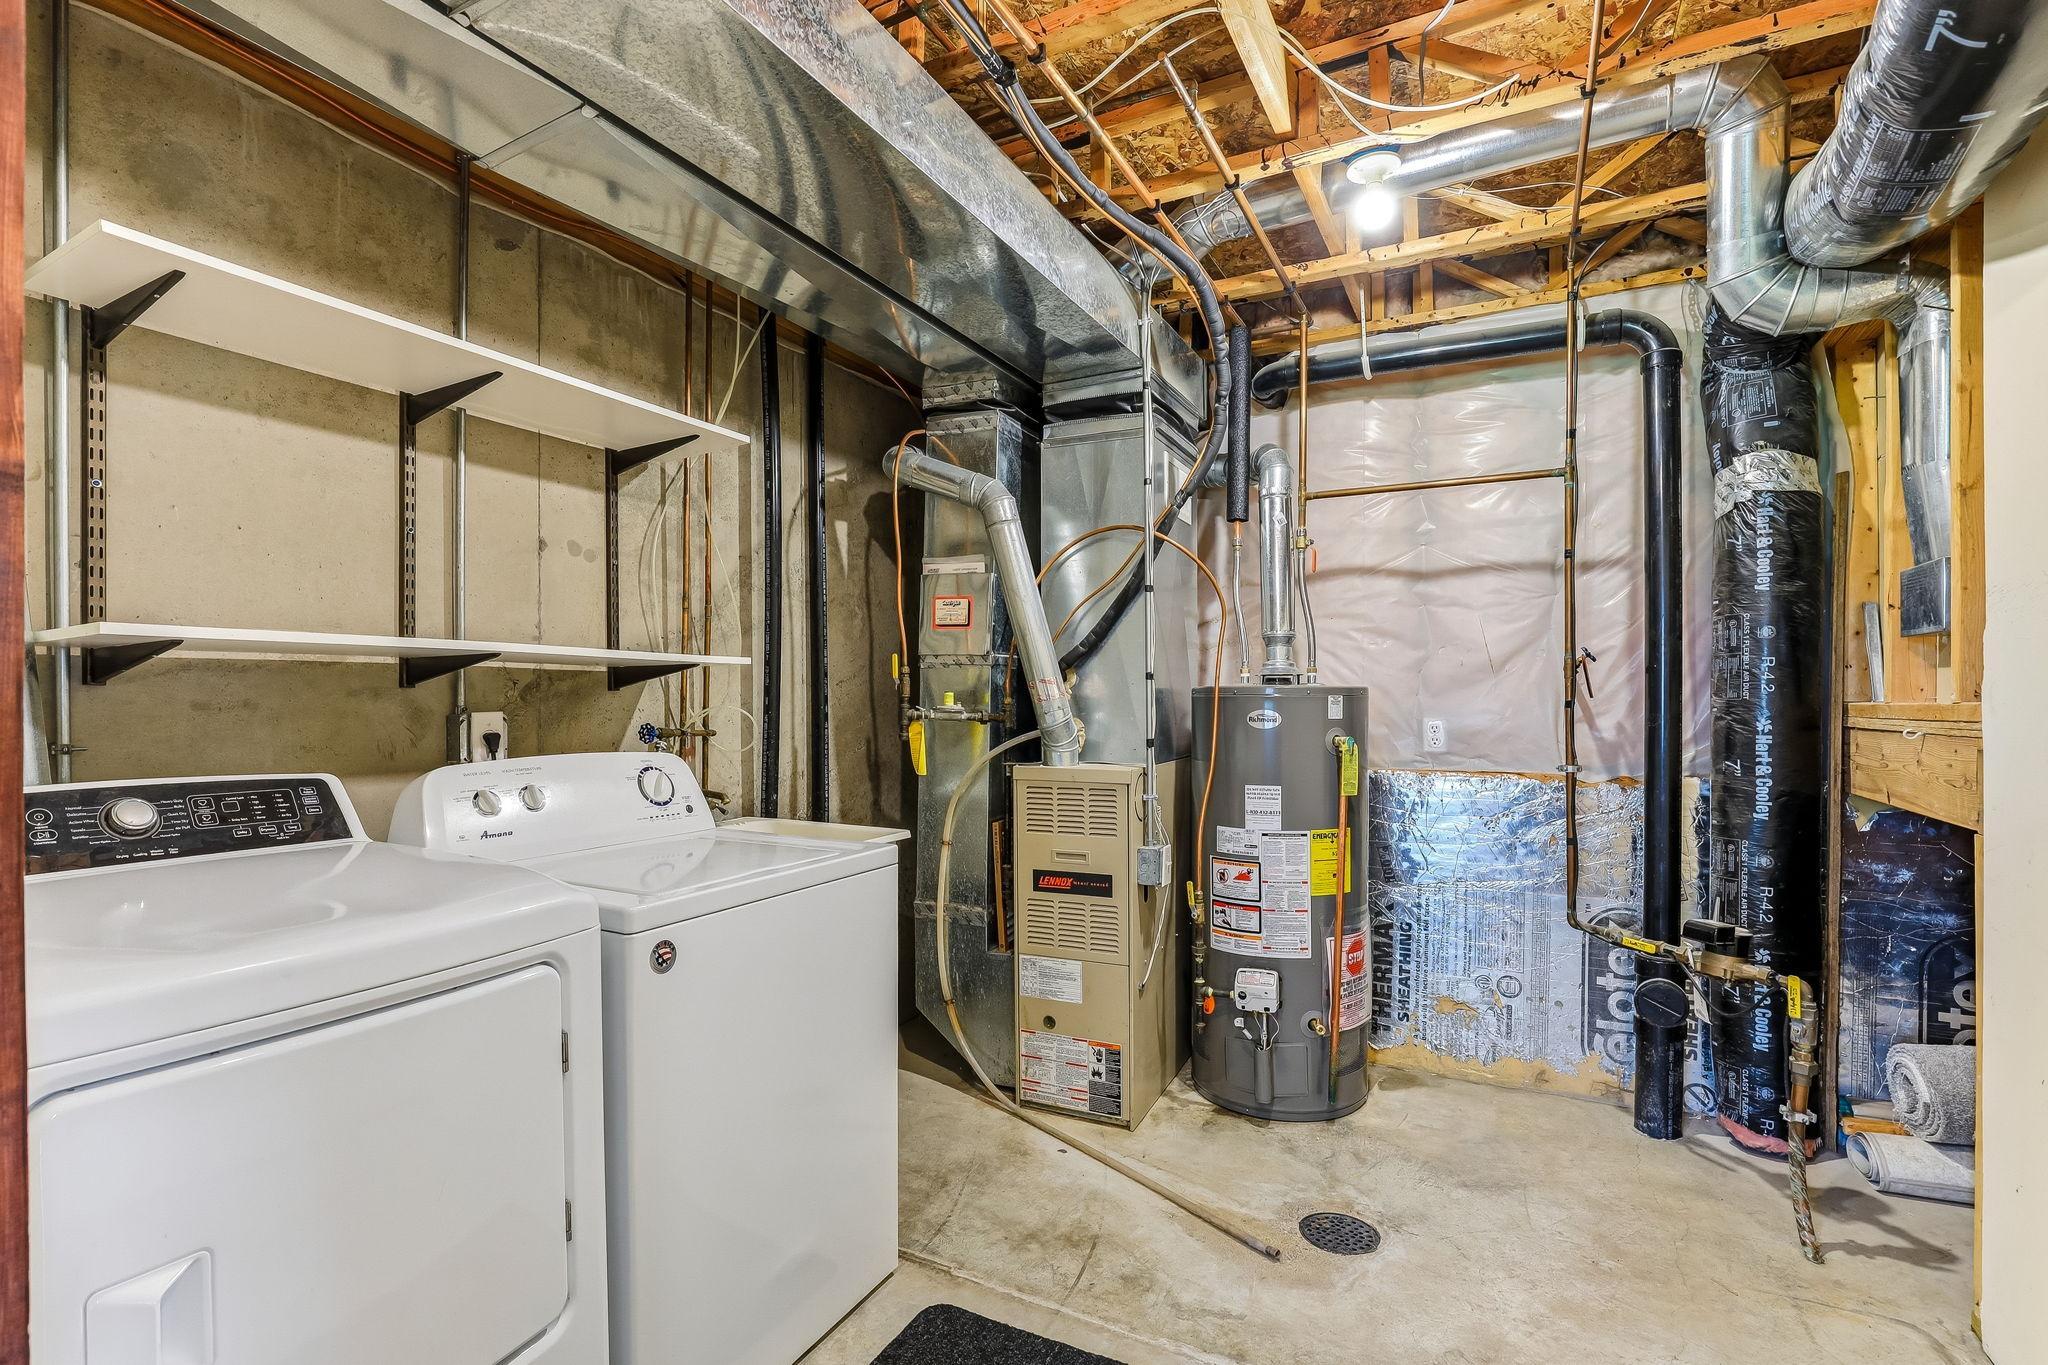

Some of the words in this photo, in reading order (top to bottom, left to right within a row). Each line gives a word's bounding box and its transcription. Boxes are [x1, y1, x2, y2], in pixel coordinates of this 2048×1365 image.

[1757, 507, 1774, 536] Hart
[1728, 534, 1742, 552] 7"
[1756, 538, 1773, 549] &
[1755, 549, 1774, 593] Cooley
[1742, 613, 1750, 633] CLASS
[1761, 656, 1775, 693] R-4.2
[1742, 683, 1750, 700] DUCT
[1248, 715, 1278, 723] Richmond
[1756, 735, 1773, 762] Hart
[1724, 759, 1741, 777] 7"
[1755, 764, 1773, 776] &
[1753, 777, 1773, 821] Cooley
[480, 830, 513, 840] Amana
[1038, 875, 1074, 887] LENNOX
[1759, 886, 1774, 922] R-4.2
[1348, 950, 1364, 964] STOP
[1371, 902, 1395, 1036] THERMAX
[1397, 921, 1412, 1023] SHEATHING
[1754, 1007, 1773, 1052] Cooley
[1742, 1069, 1750, 1089] CLASS
